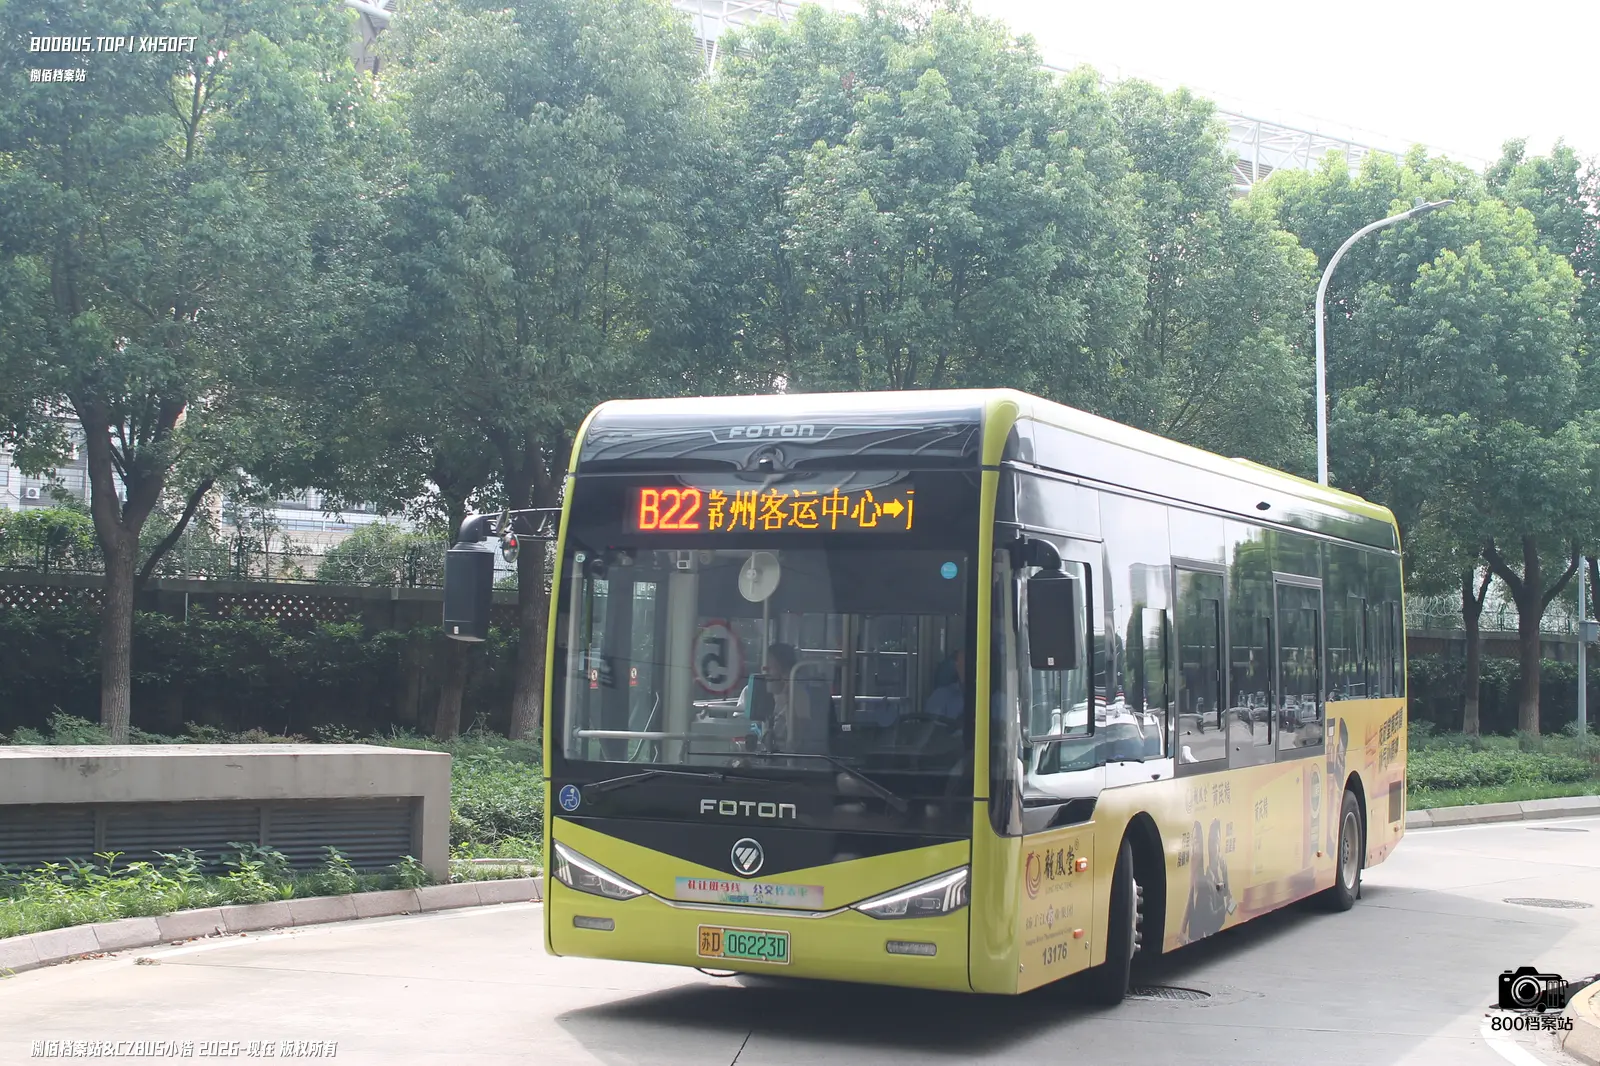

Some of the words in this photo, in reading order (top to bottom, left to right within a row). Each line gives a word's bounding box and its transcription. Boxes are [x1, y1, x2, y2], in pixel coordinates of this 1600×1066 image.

[728, 424, 815, 439] FOTON
[638, 488, 701, 531] B22
[699, 798, 797, 819] FOTON
[701, 932, 721, 952] 苏D
[728, 934, 786, 958] 06223D
[1042, 941, 1068, 966] 13176
